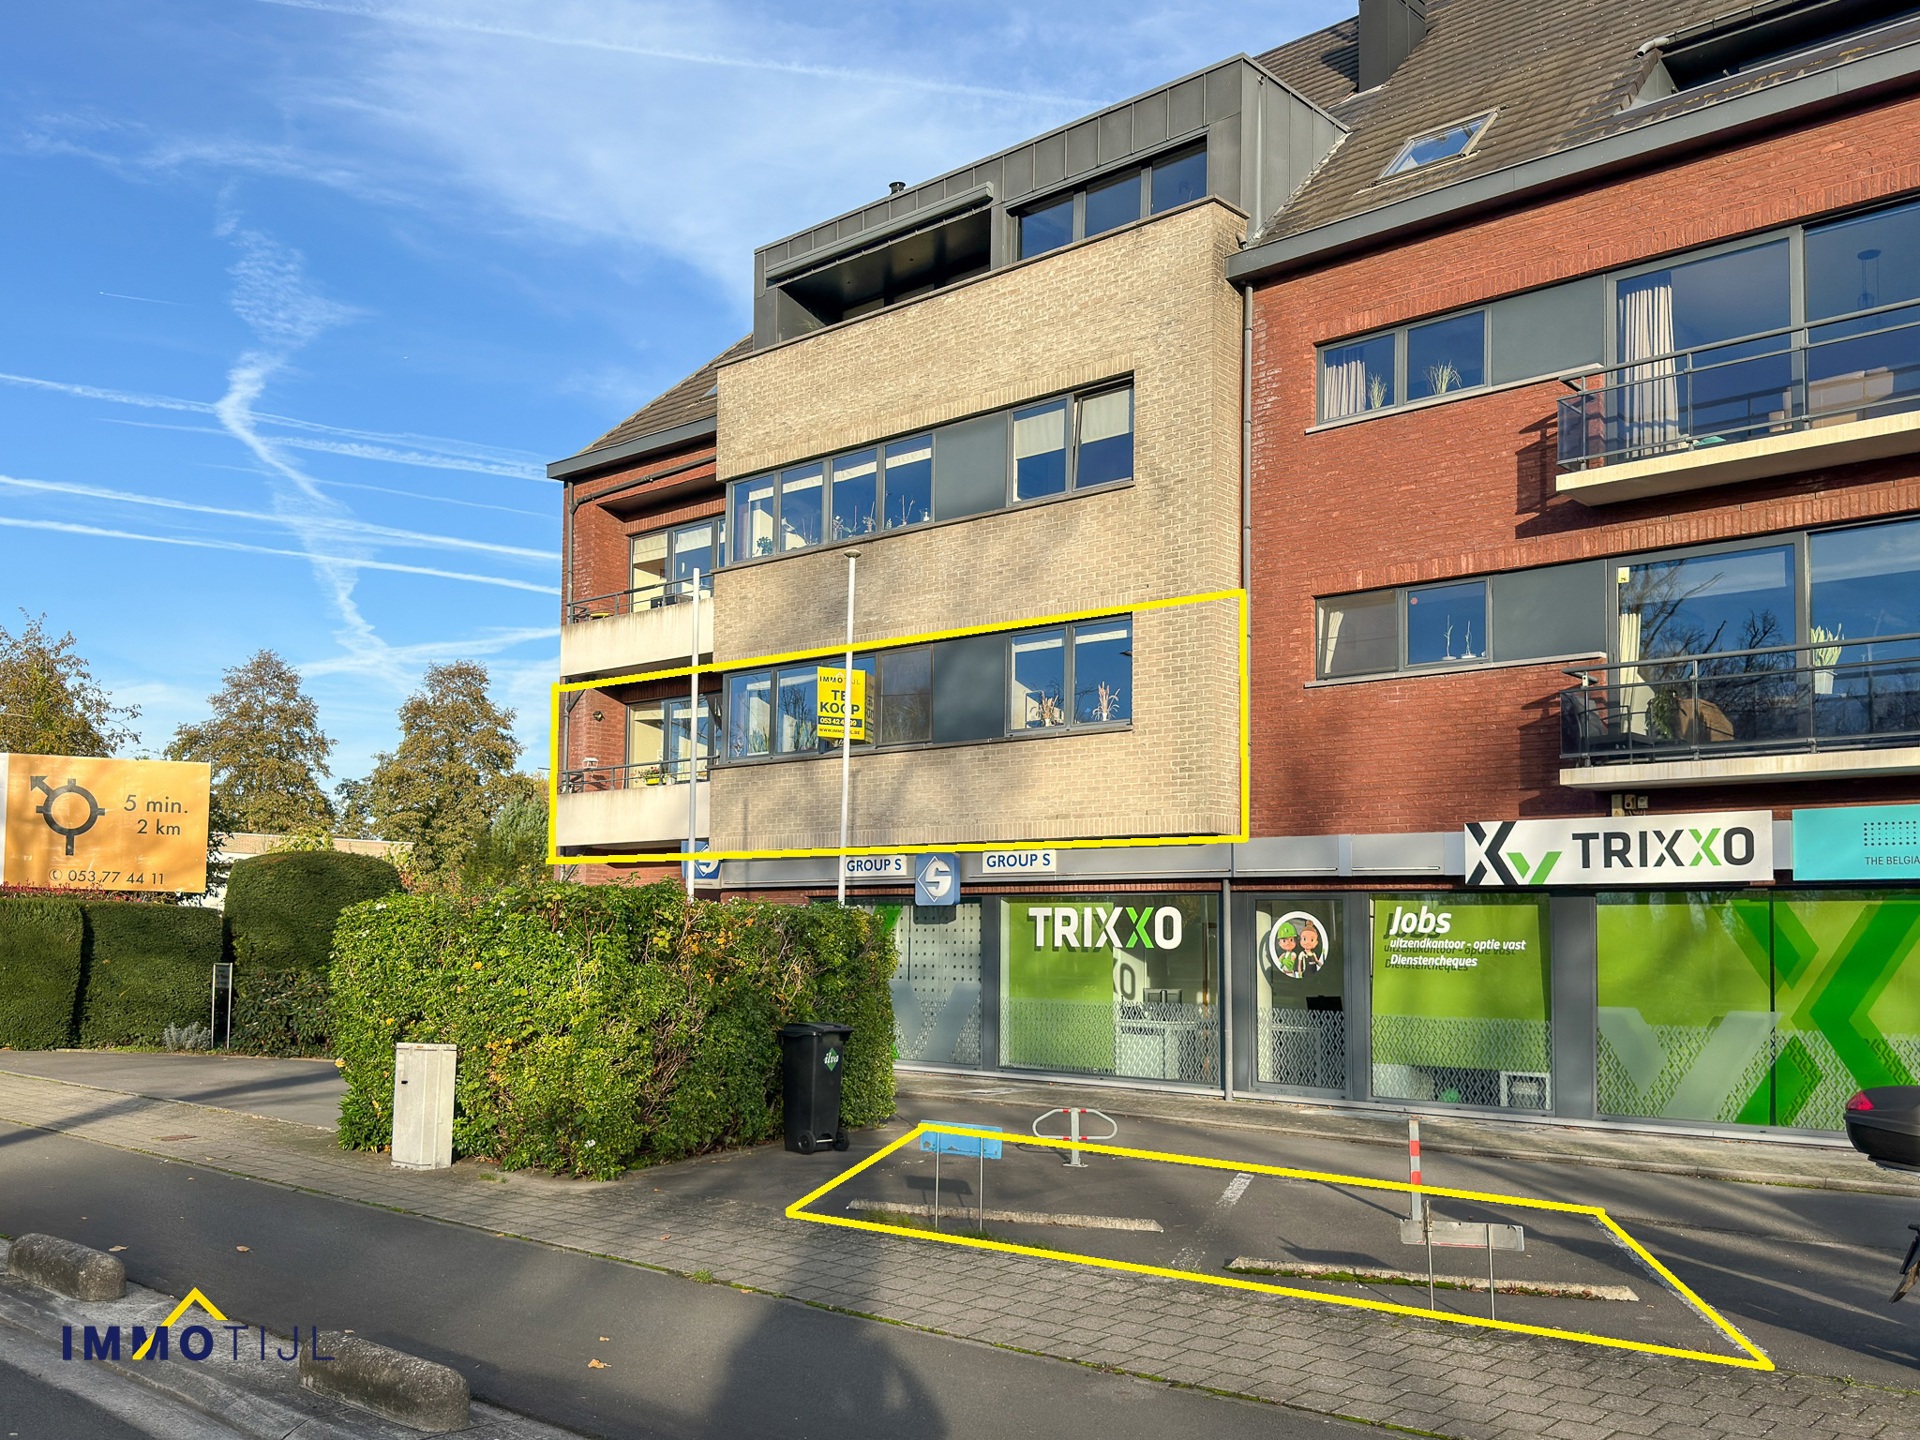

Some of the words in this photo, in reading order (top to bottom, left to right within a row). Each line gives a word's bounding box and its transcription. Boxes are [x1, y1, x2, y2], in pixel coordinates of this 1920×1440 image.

[124, 794, 136, 811] 5
[146, 796, 188, 814] min.
[137, 819, 148, 834] 2
[156, 818, 180, 835] km
[1571, 826, 1755, 869] TRIXXO
[847, 859, 891, 872] GROUP
[894, 858, 902, 871] S
[986, 854, 1038, 868] GROUP
[1042, 853, 1051, 866] S
[1865, 856, 1883, 865] THE
[68, 869, 96, 882] 053
[101, 871, 121, 883] 77
[126, 872, 144, 884] 44
[152, 873, 164, 884] 11
[1028, 906, 1182, 949] TRIXXO
[1389, 905, 1452, 935] Jobs
[1389, 937, 1465, 950] uitzendkantoor
[1473, 939, 1500, 952] optie
[1502, 939, 1526, 950] vast
[1390, 953, 1478, 969] Dienstencheques
